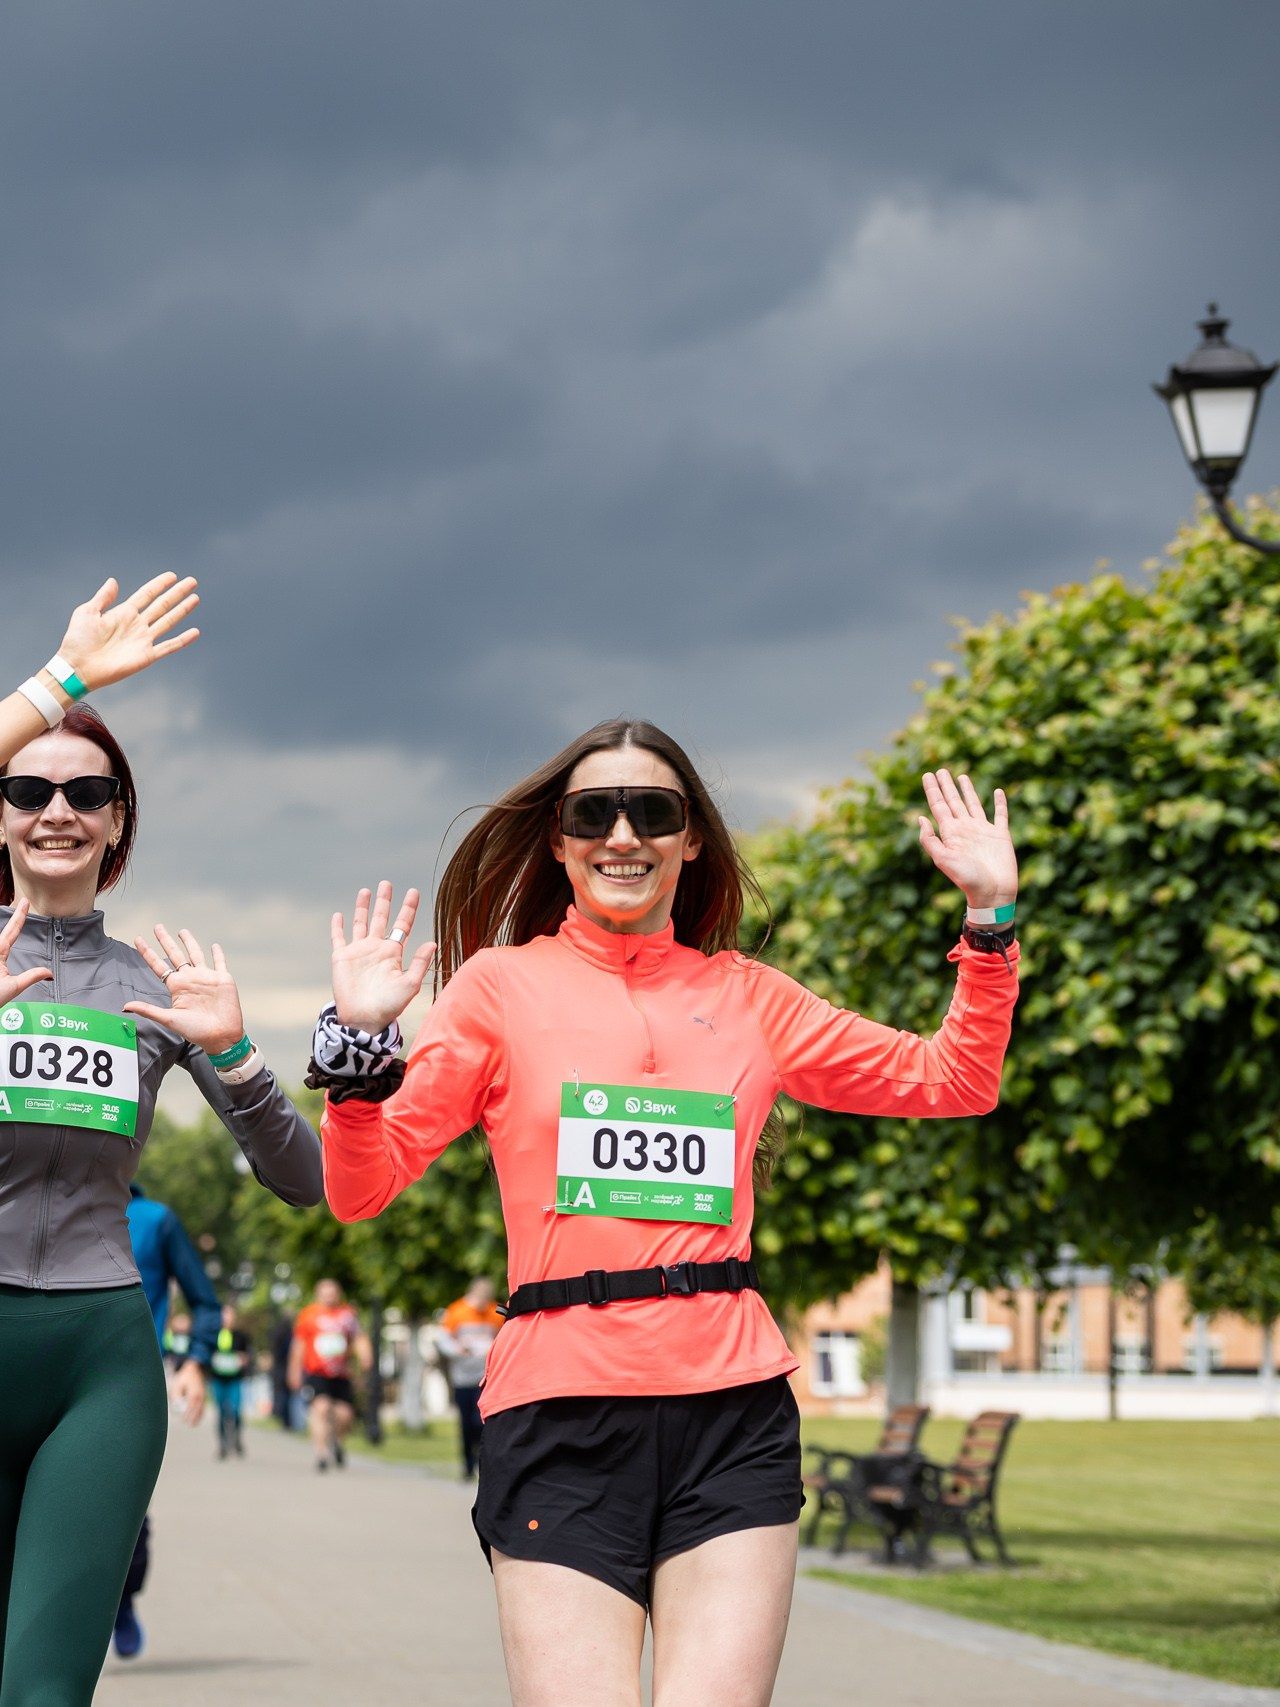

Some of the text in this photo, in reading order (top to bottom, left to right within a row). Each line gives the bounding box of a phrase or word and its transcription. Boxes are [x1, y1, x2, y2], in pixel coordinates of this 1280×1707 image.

[6, 1013, 20, 1023] 4,2
[58, 1016, 88, 1031] Звук
[9, 1041, 113, 1088] 0328
[588, 1095, 603, 1106] 4,2
[102, 1103, 120, 1113] 30.05
[643, 1099, 677, 1116] Звук
[102, 1112, 118, 1122] 2026
[593, 1127, 705, 1175] 0330
[694, 1193, 714, 1203] 30.05
[694, 1202, 712, 1212] 2026
